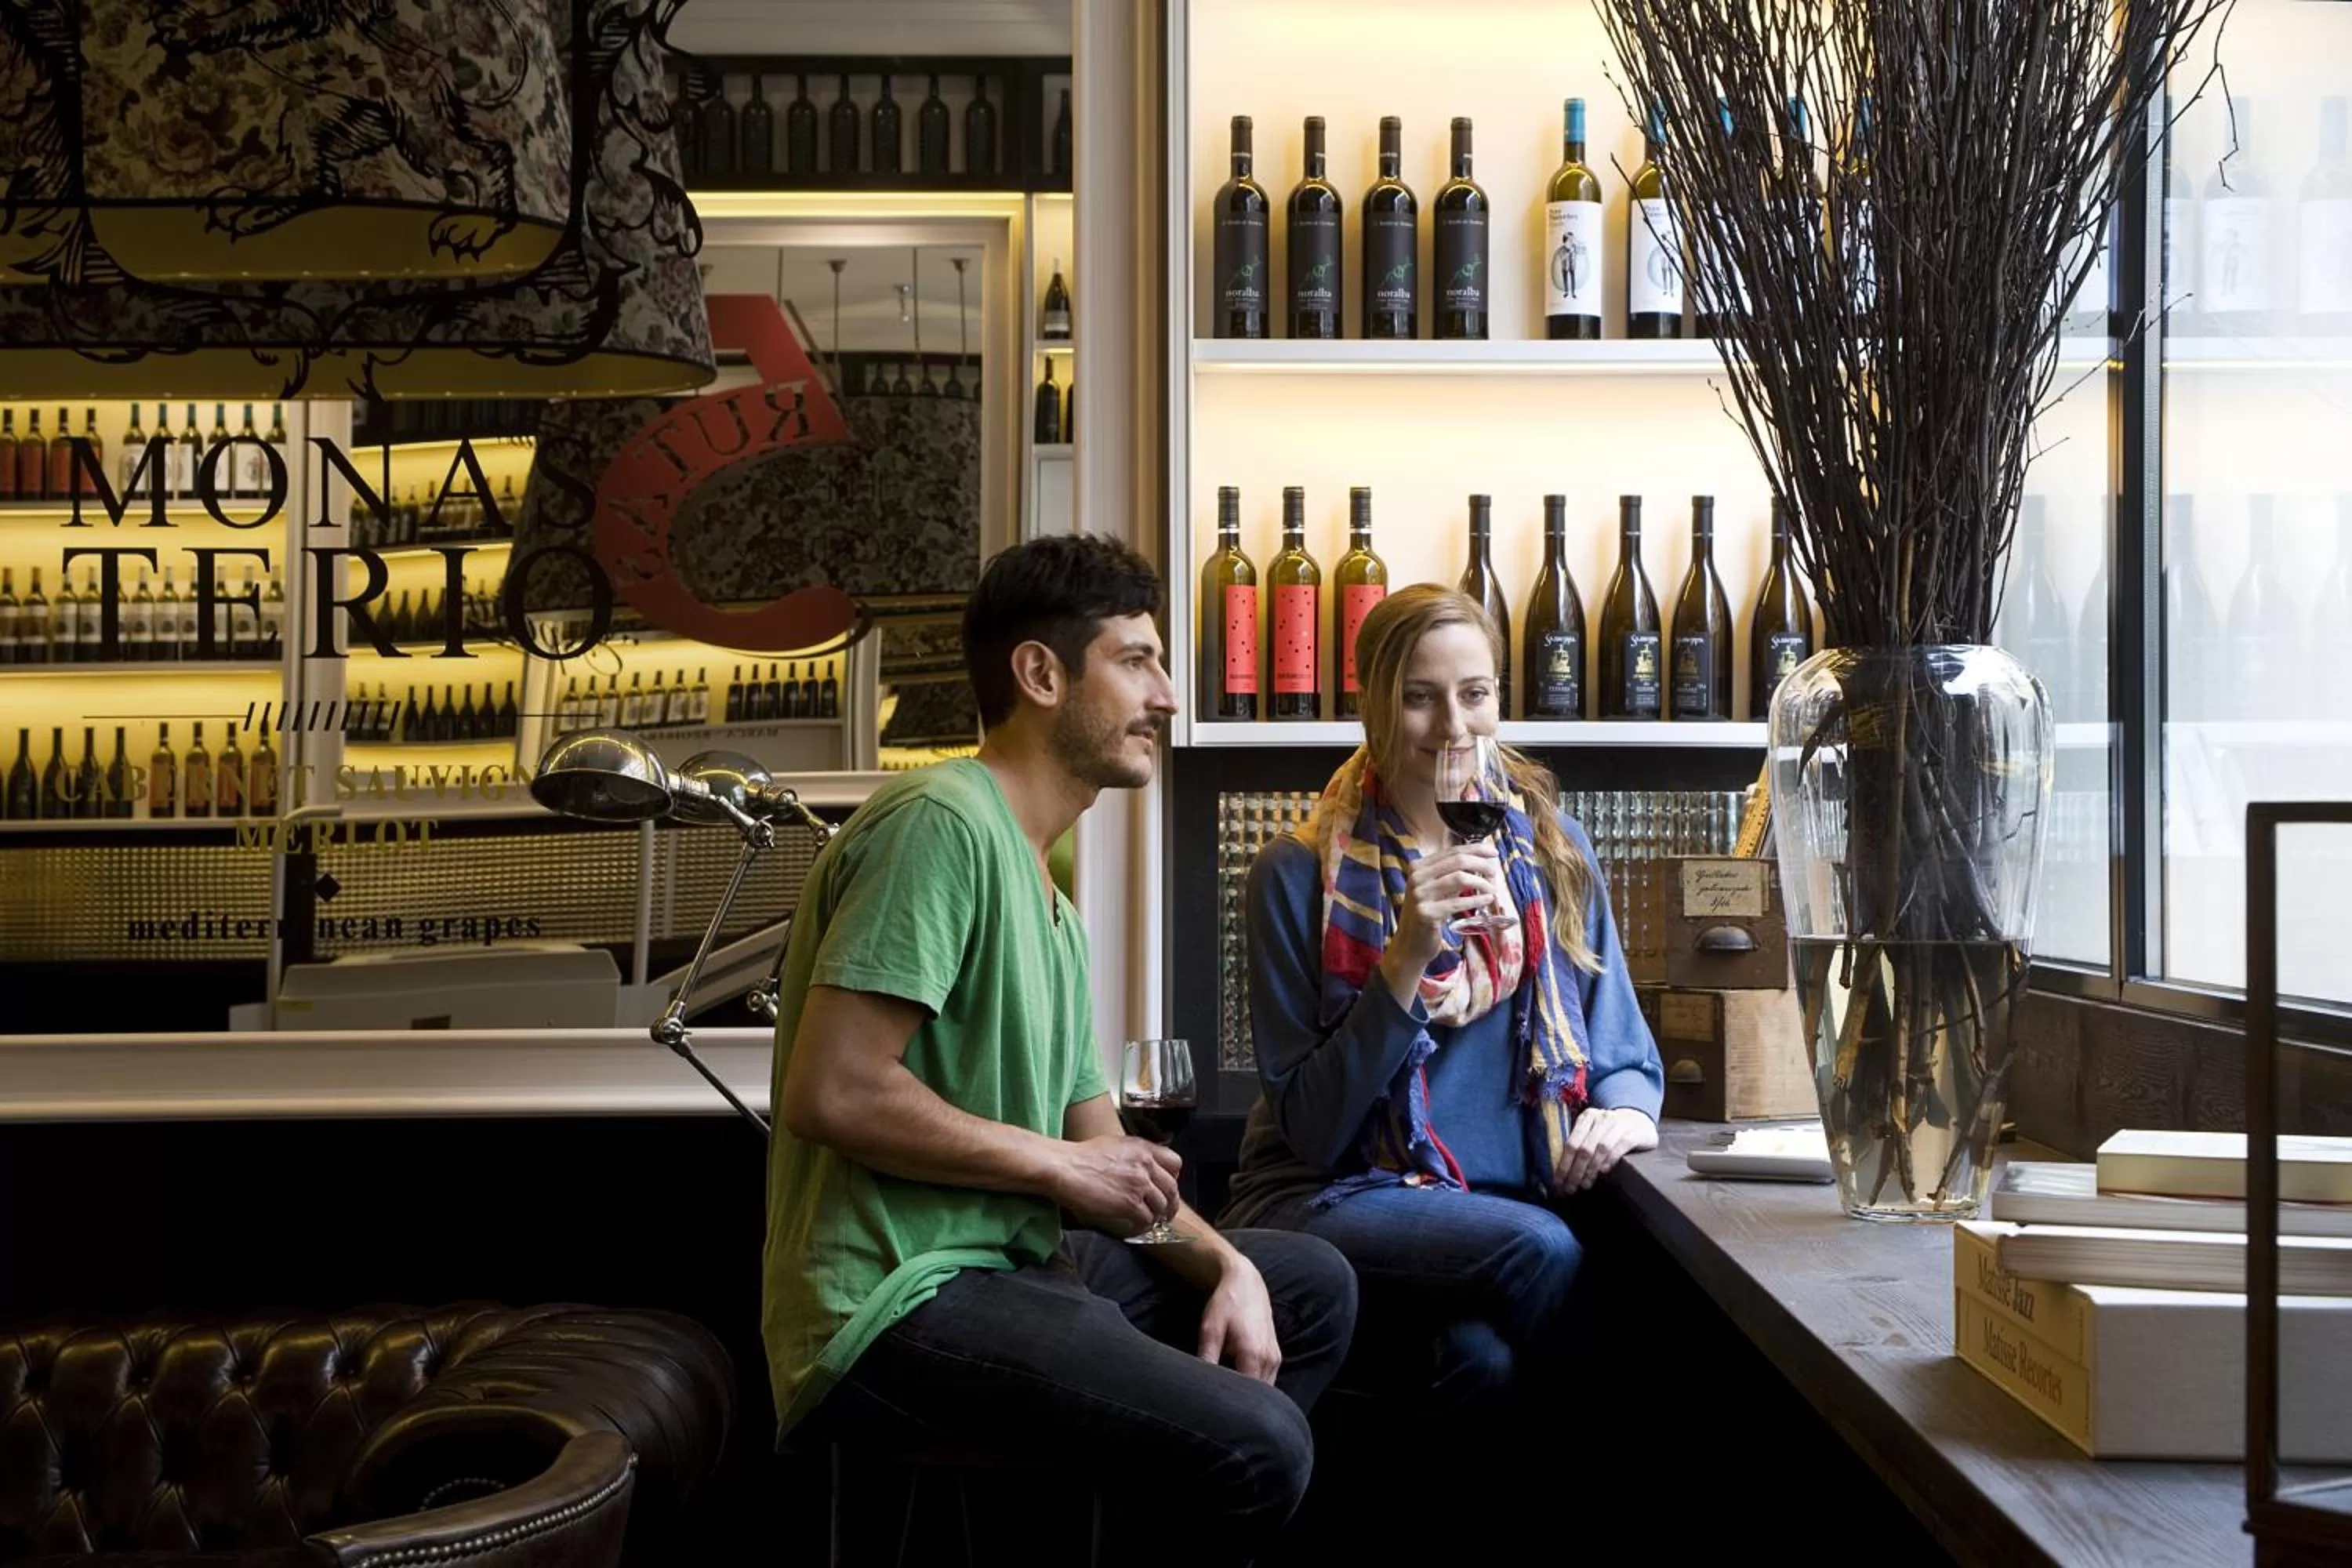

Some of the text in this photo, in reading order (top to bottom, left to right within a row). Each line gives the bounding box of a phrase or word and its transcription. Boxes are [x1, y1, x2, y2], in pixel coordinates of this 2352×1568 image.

[60, 436, 597, 528] MONAS
[62, 546, 613, 660] TERIO
[54, 764, 539, 803] CABERNET SAUVIGN
[236, 818, 438, 855] MERLOT
[419, 916, 541, 946] grapes
[2012, 1278, 2035, 1323] Jazz
[1983, 1316, 2018, 1374] Matisse
